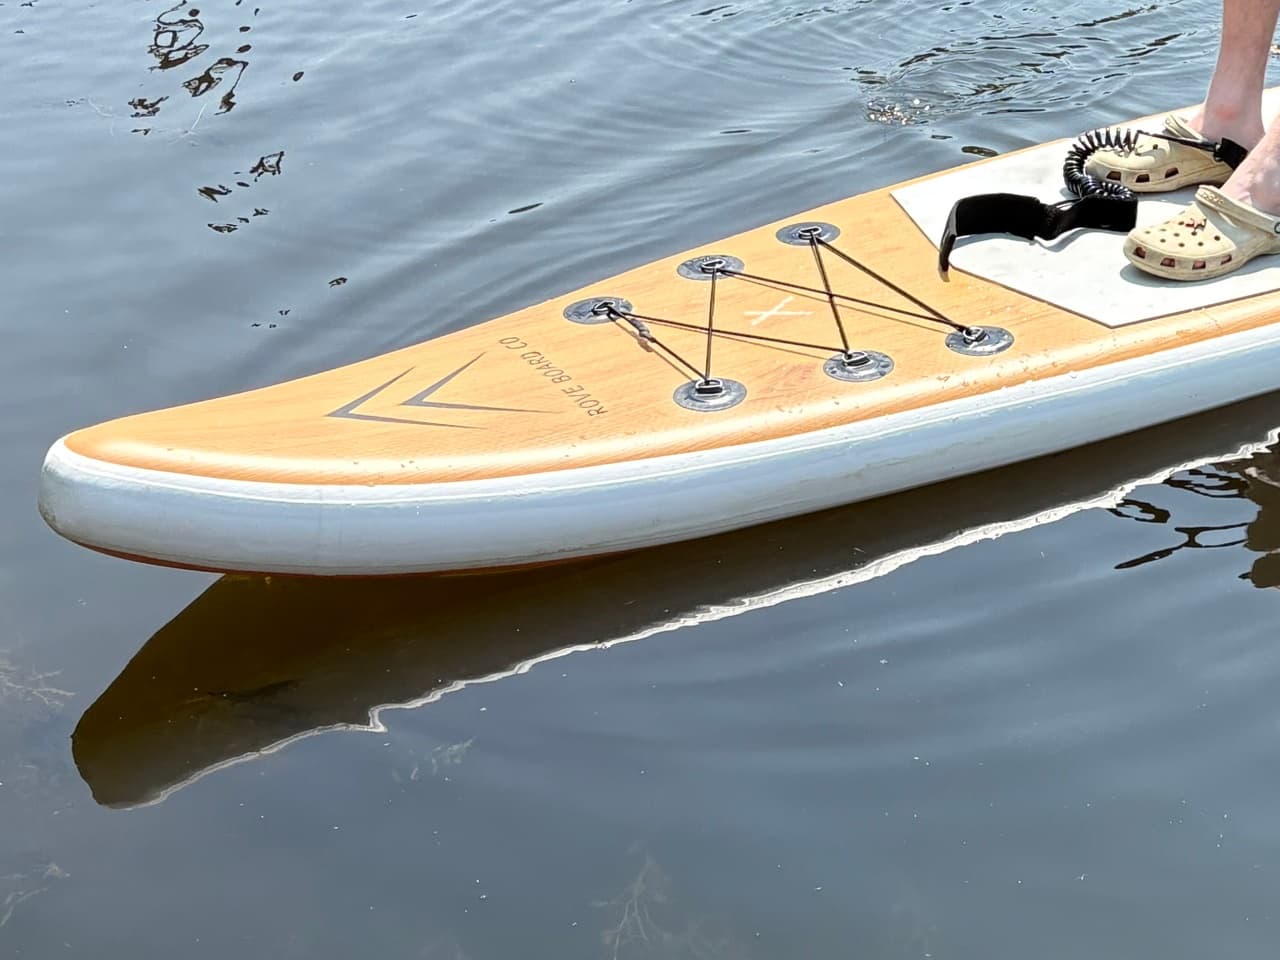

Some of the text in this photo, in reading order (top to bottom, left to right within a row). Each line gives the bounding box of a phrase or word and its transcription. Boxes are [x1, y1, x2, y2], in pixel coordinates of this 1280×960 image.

[498, 336, 608, 417] ROVE BOARD CO
